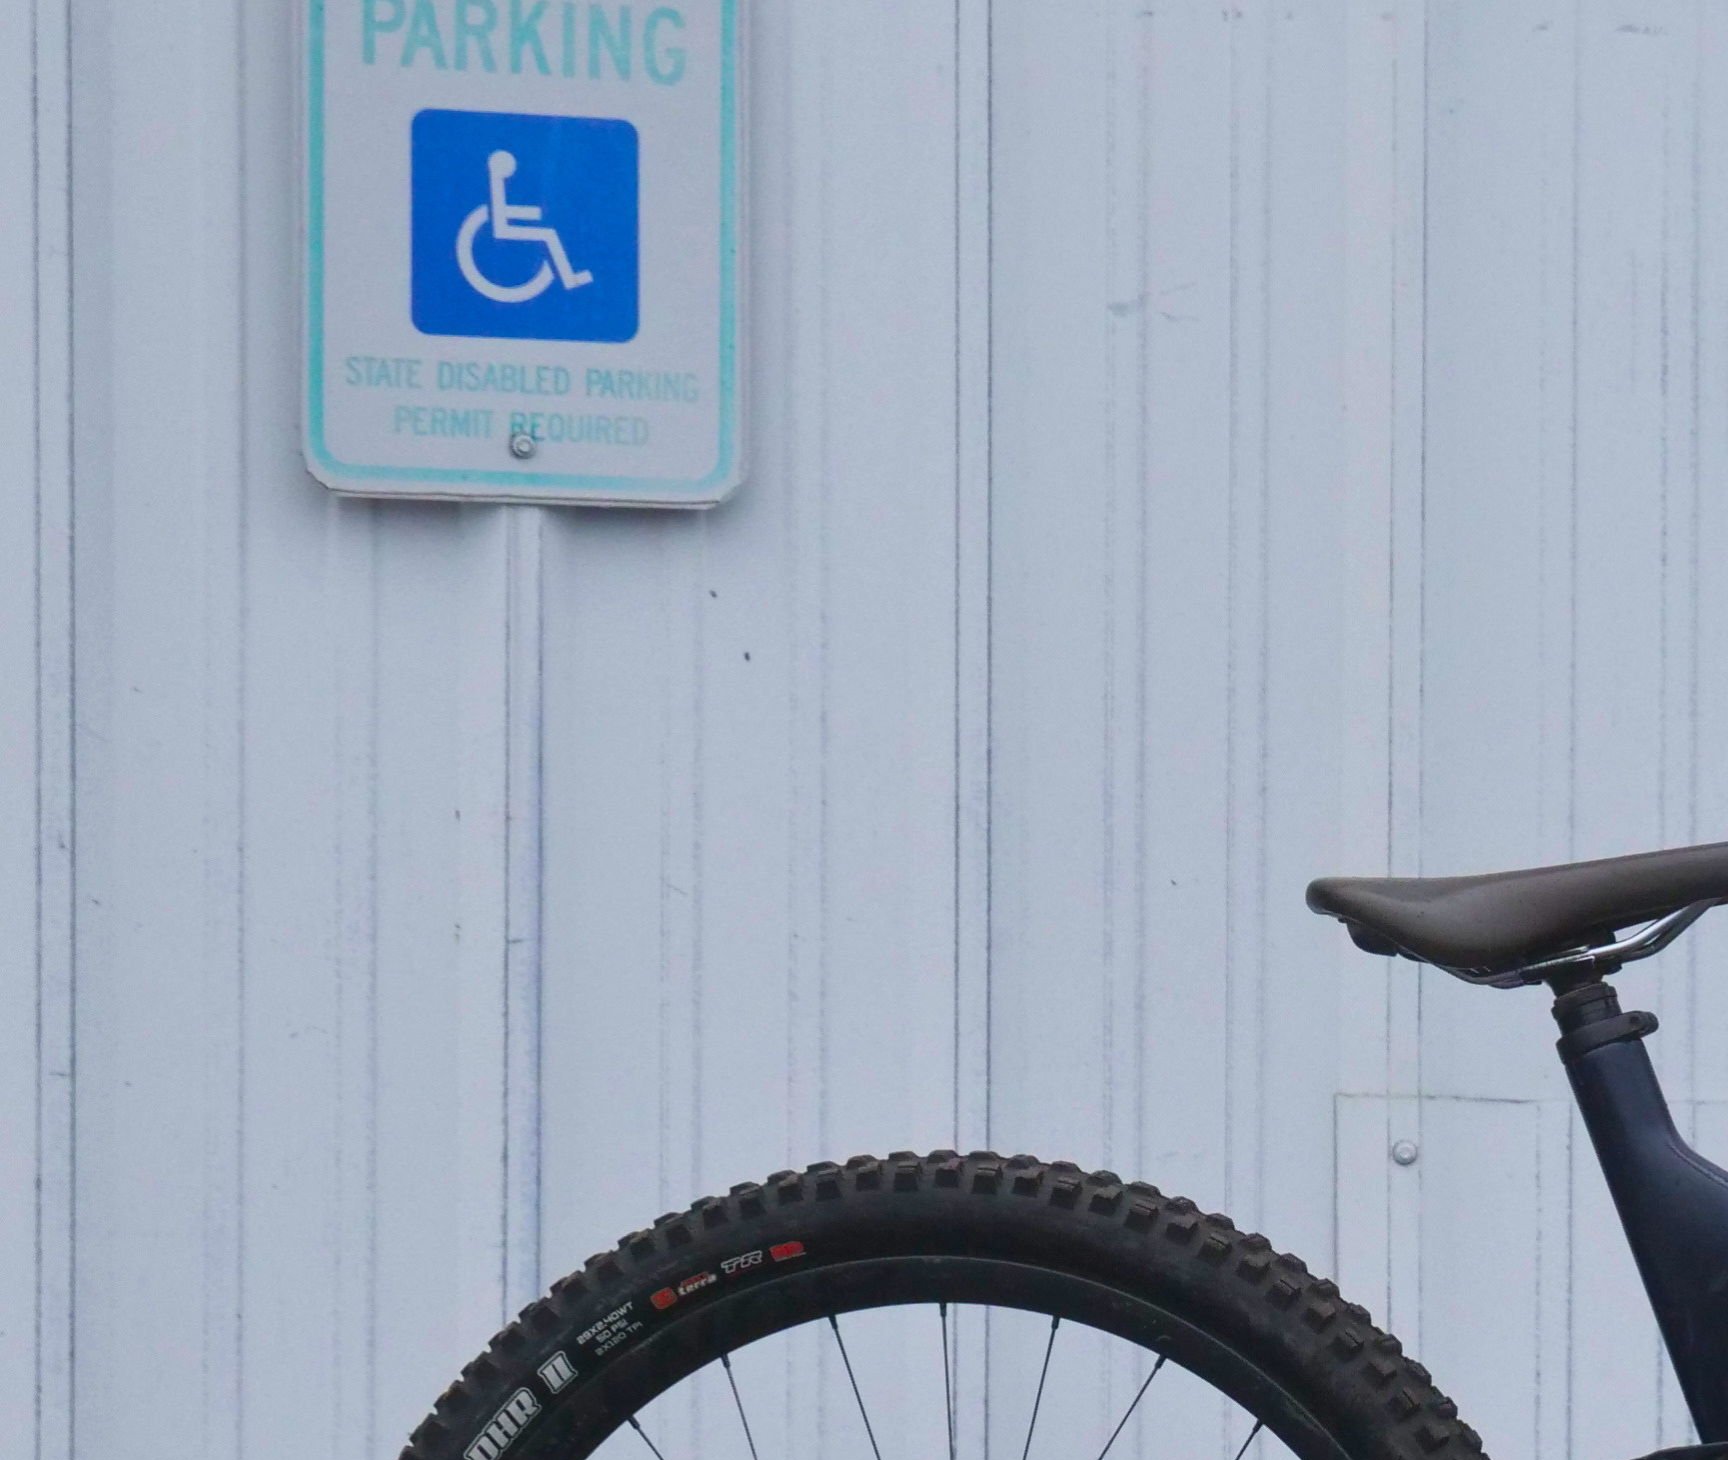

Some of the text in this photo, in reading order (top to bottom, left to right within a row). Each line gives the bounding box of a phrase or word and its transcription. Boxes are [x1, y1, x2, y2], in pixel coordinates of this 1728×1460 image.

[361, 0, 688, 86] PARKING
[345, 356, 699, 403] STATE DISABLED PARKING
[394, 405, 650, 447] PERMIT REQUIRED
[537, 1351, 578, 1394] II
